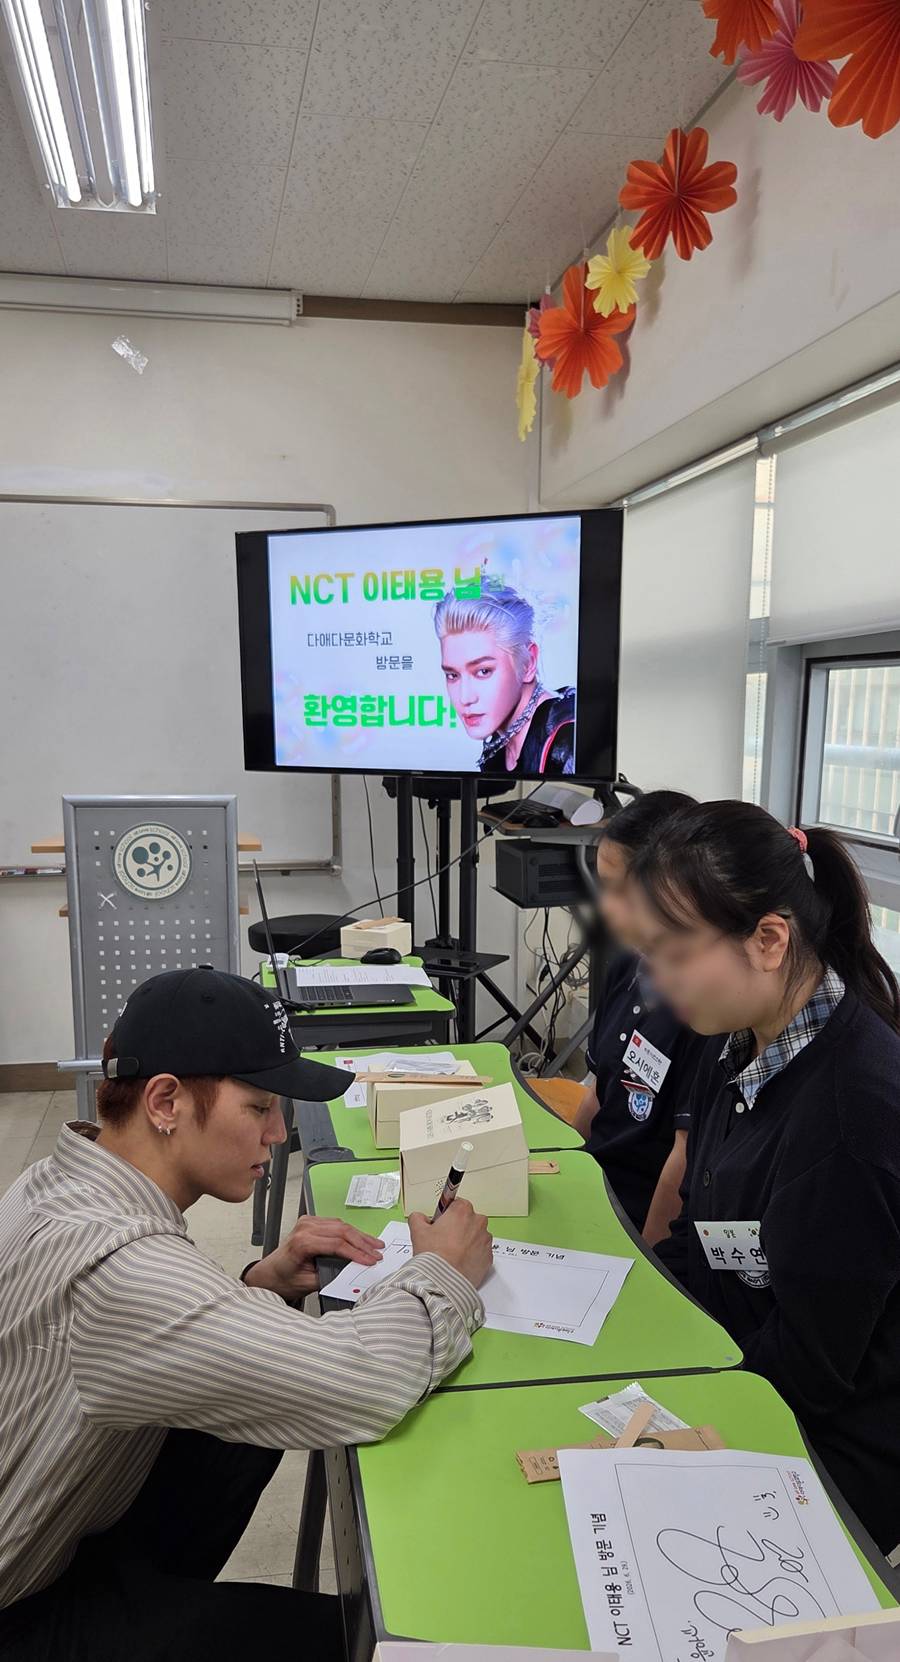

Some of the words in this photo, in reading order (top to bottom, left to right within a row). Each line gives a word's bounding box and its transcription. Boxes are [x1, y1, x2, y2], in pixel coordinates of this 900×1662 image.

[290, 571, 355, 605] NCT
[362, 568, 445, 602] 이태용
[307, 631, 393, 647] 다애다문화학교
[376, 655, 414, 670] 방문을
[303, 694, 457, 728] 환영합니다!
[590, 1513, 607, 1535] 기념
[595, 1539, 615, 1561] 방문
[600, 1566, 618, 1577] 님
[604, 1582, 624, 1616] 이태용
[613, 1620, 633, 1646] NCT
